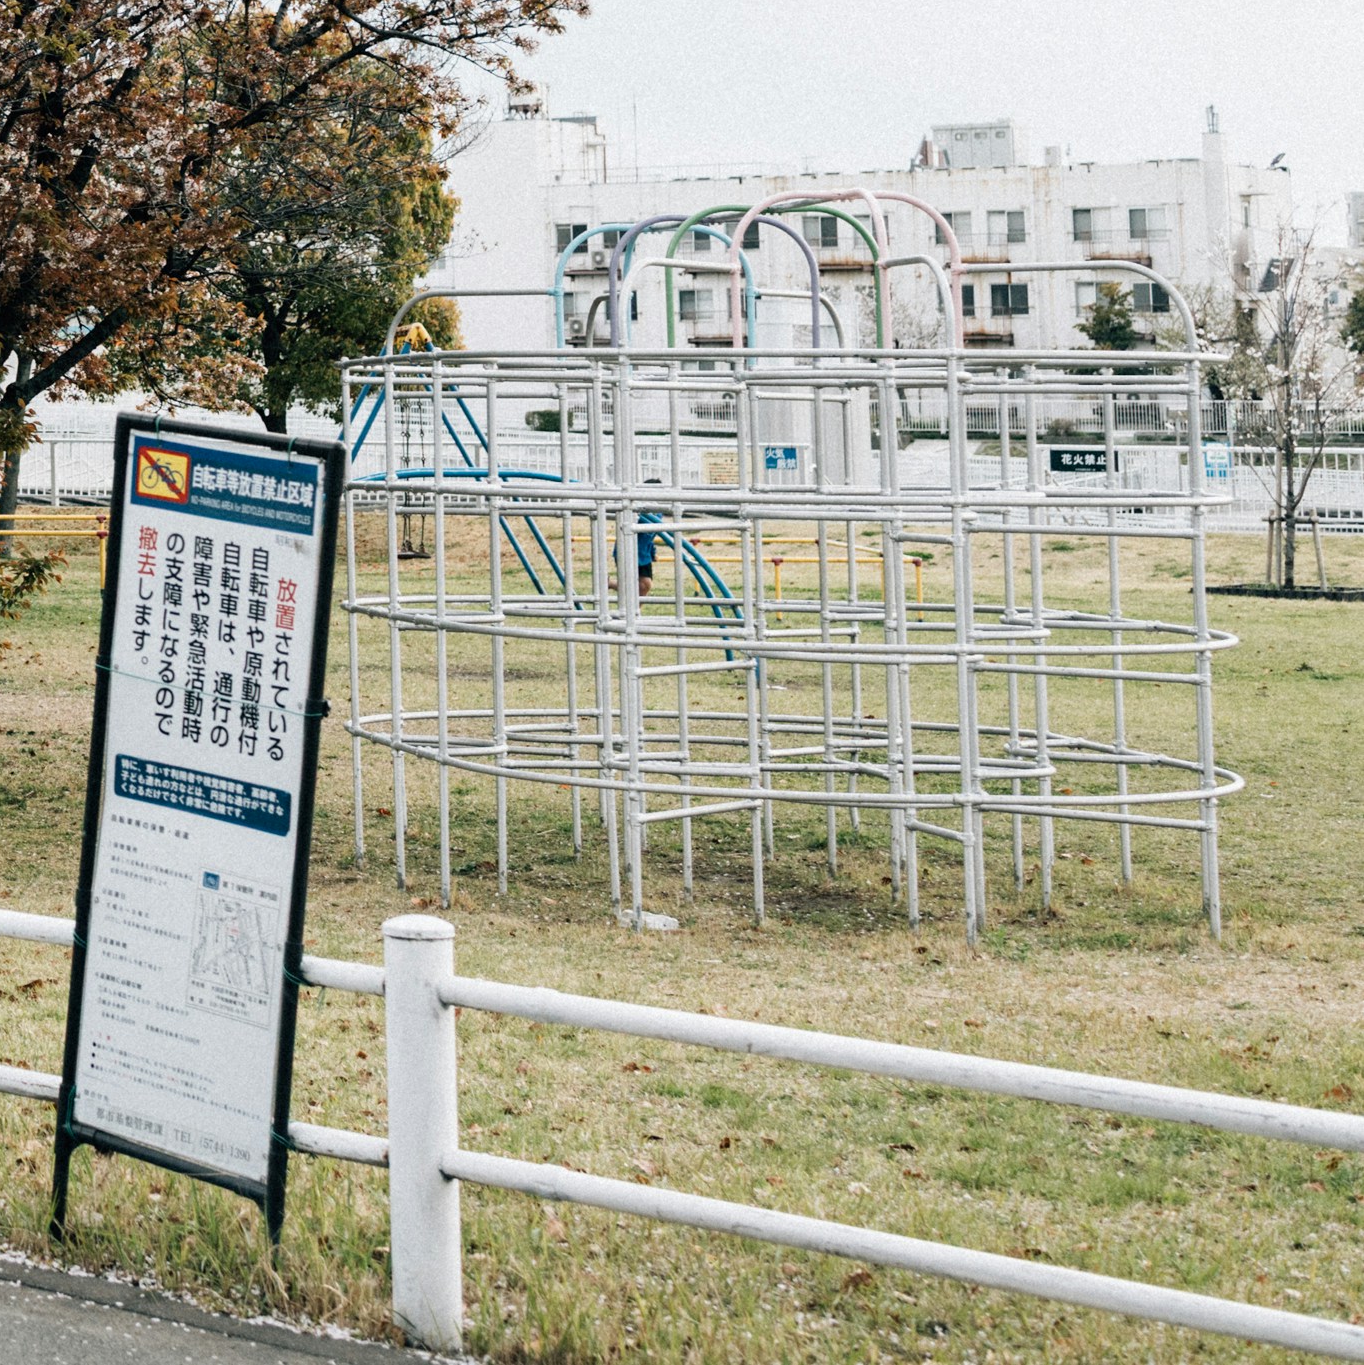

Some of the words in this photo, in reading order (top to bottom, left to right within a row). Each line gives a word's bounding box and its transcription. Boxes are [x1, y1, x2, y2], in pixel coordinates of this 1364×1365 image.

[192, 463, 314, 508] 自転車等放置禁止区域
[1061, 453, 1107, 466] 花火禁止
[132, 525, 158, 665] 撤去します。
[154, 533, 185, 736] の支障になるので
[182, 535, 214, 743] 障害や緊急活動時
[210, 542, 241, 748] 自転車は、通行の
[238, 547, 269, 757] 自転車や原動機付
[267, 577, 298, 762] 放置されている
